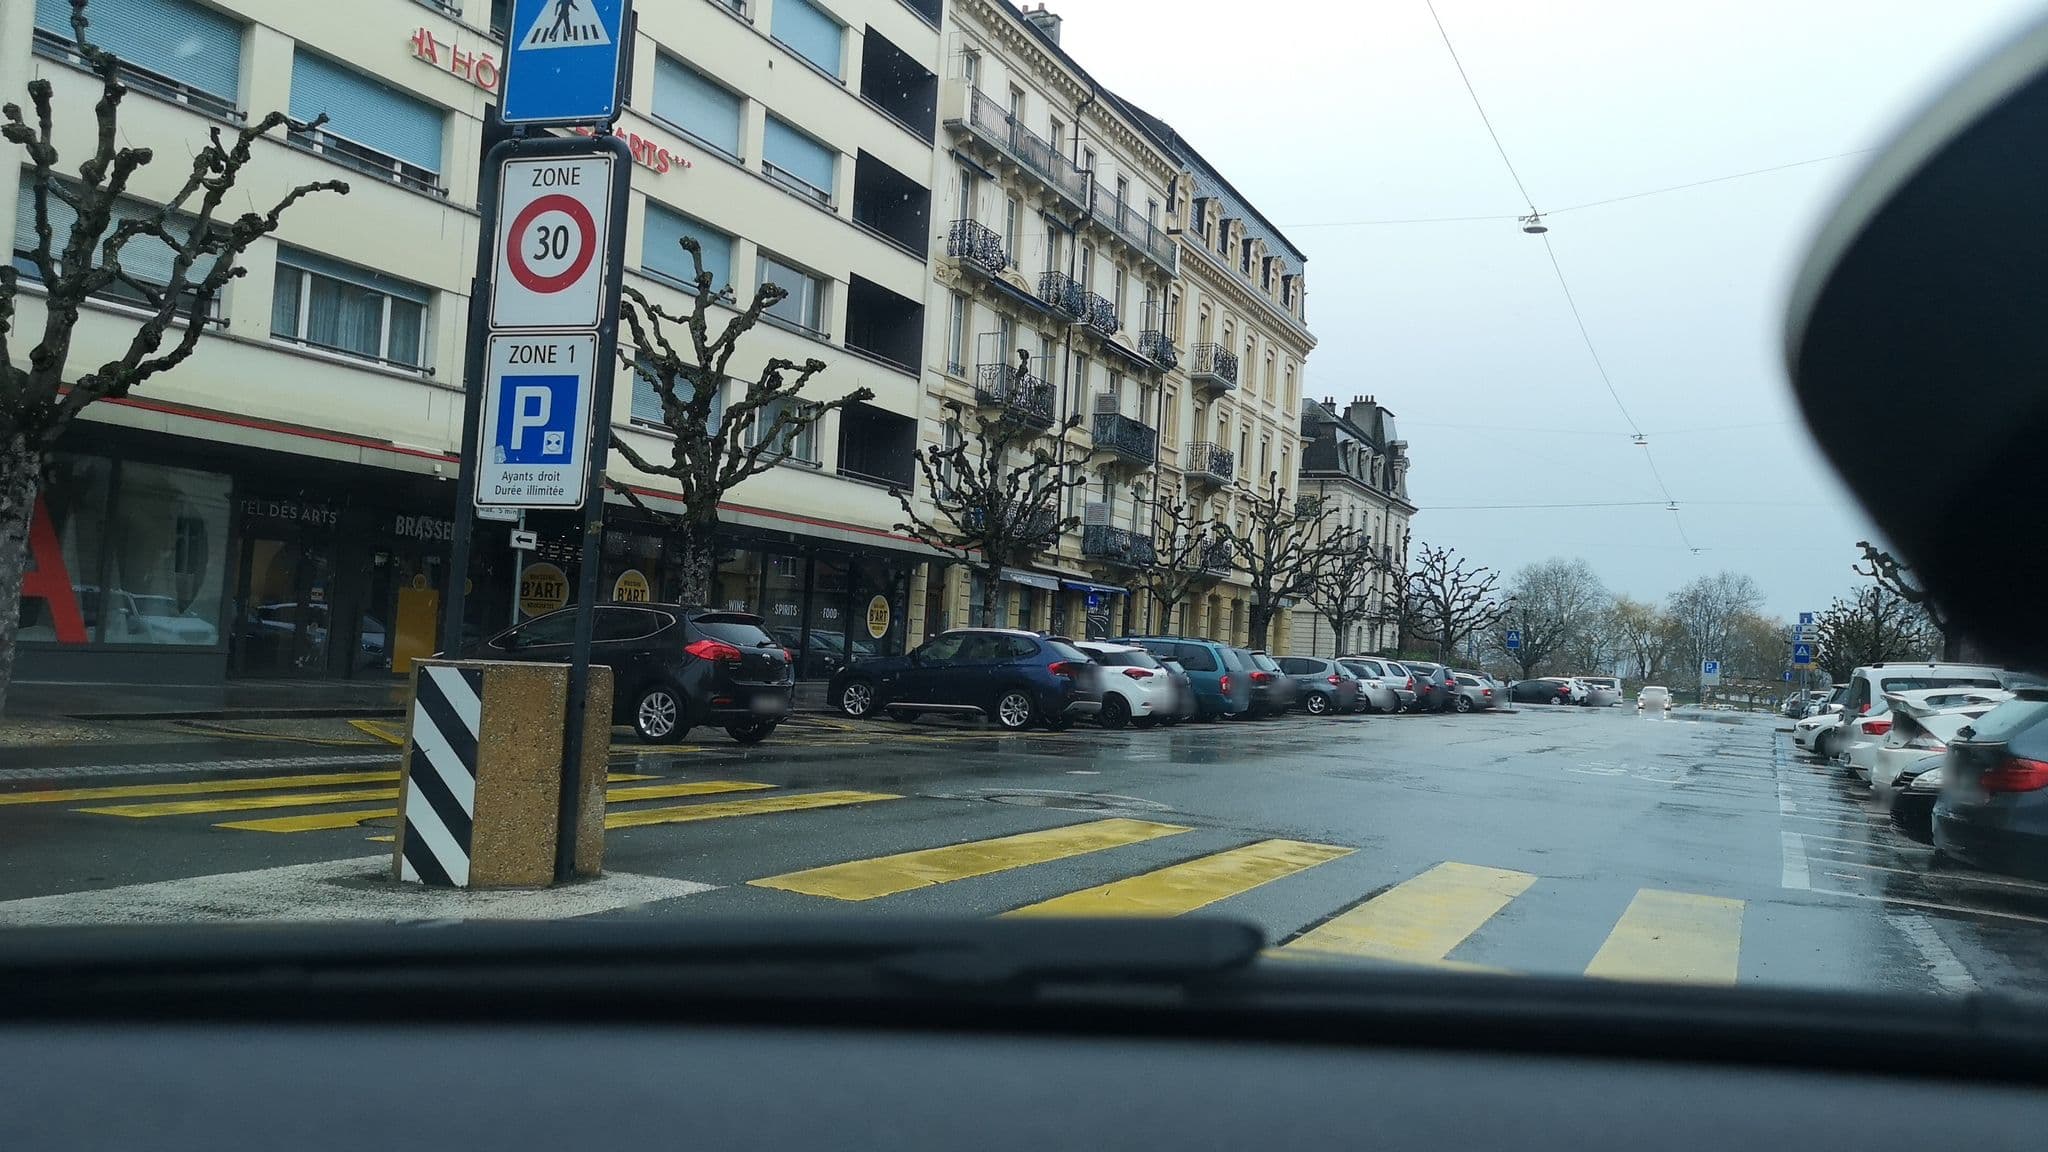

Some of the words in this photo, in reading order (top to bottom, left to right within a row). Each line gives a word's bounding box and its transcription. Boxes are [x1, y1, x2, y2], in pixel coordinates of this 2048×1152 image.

[532, 167, 581, 187] ZONE
[533, 225, 569, 260] 30
[509, 345, 558, 364] ZONE
[568, 344, 575, 363] 1
[510, 386, 552, 450] P
[501, 471, 534, 483] Ayants
[538, 471, 560, 481] droit
[495, 485, 521, 496] Durée
[526, 485, 564, 496] illimitée
[301, 507, 337, 524] ARTS
[521, 581, 563, 599] B'ART
[618, 587, 646, 602] B'ART
[728, 600, 745, 612] WINE
[774, 603, 798, 617] SPIRITS
[823, 608, 837, 619] FOOD
